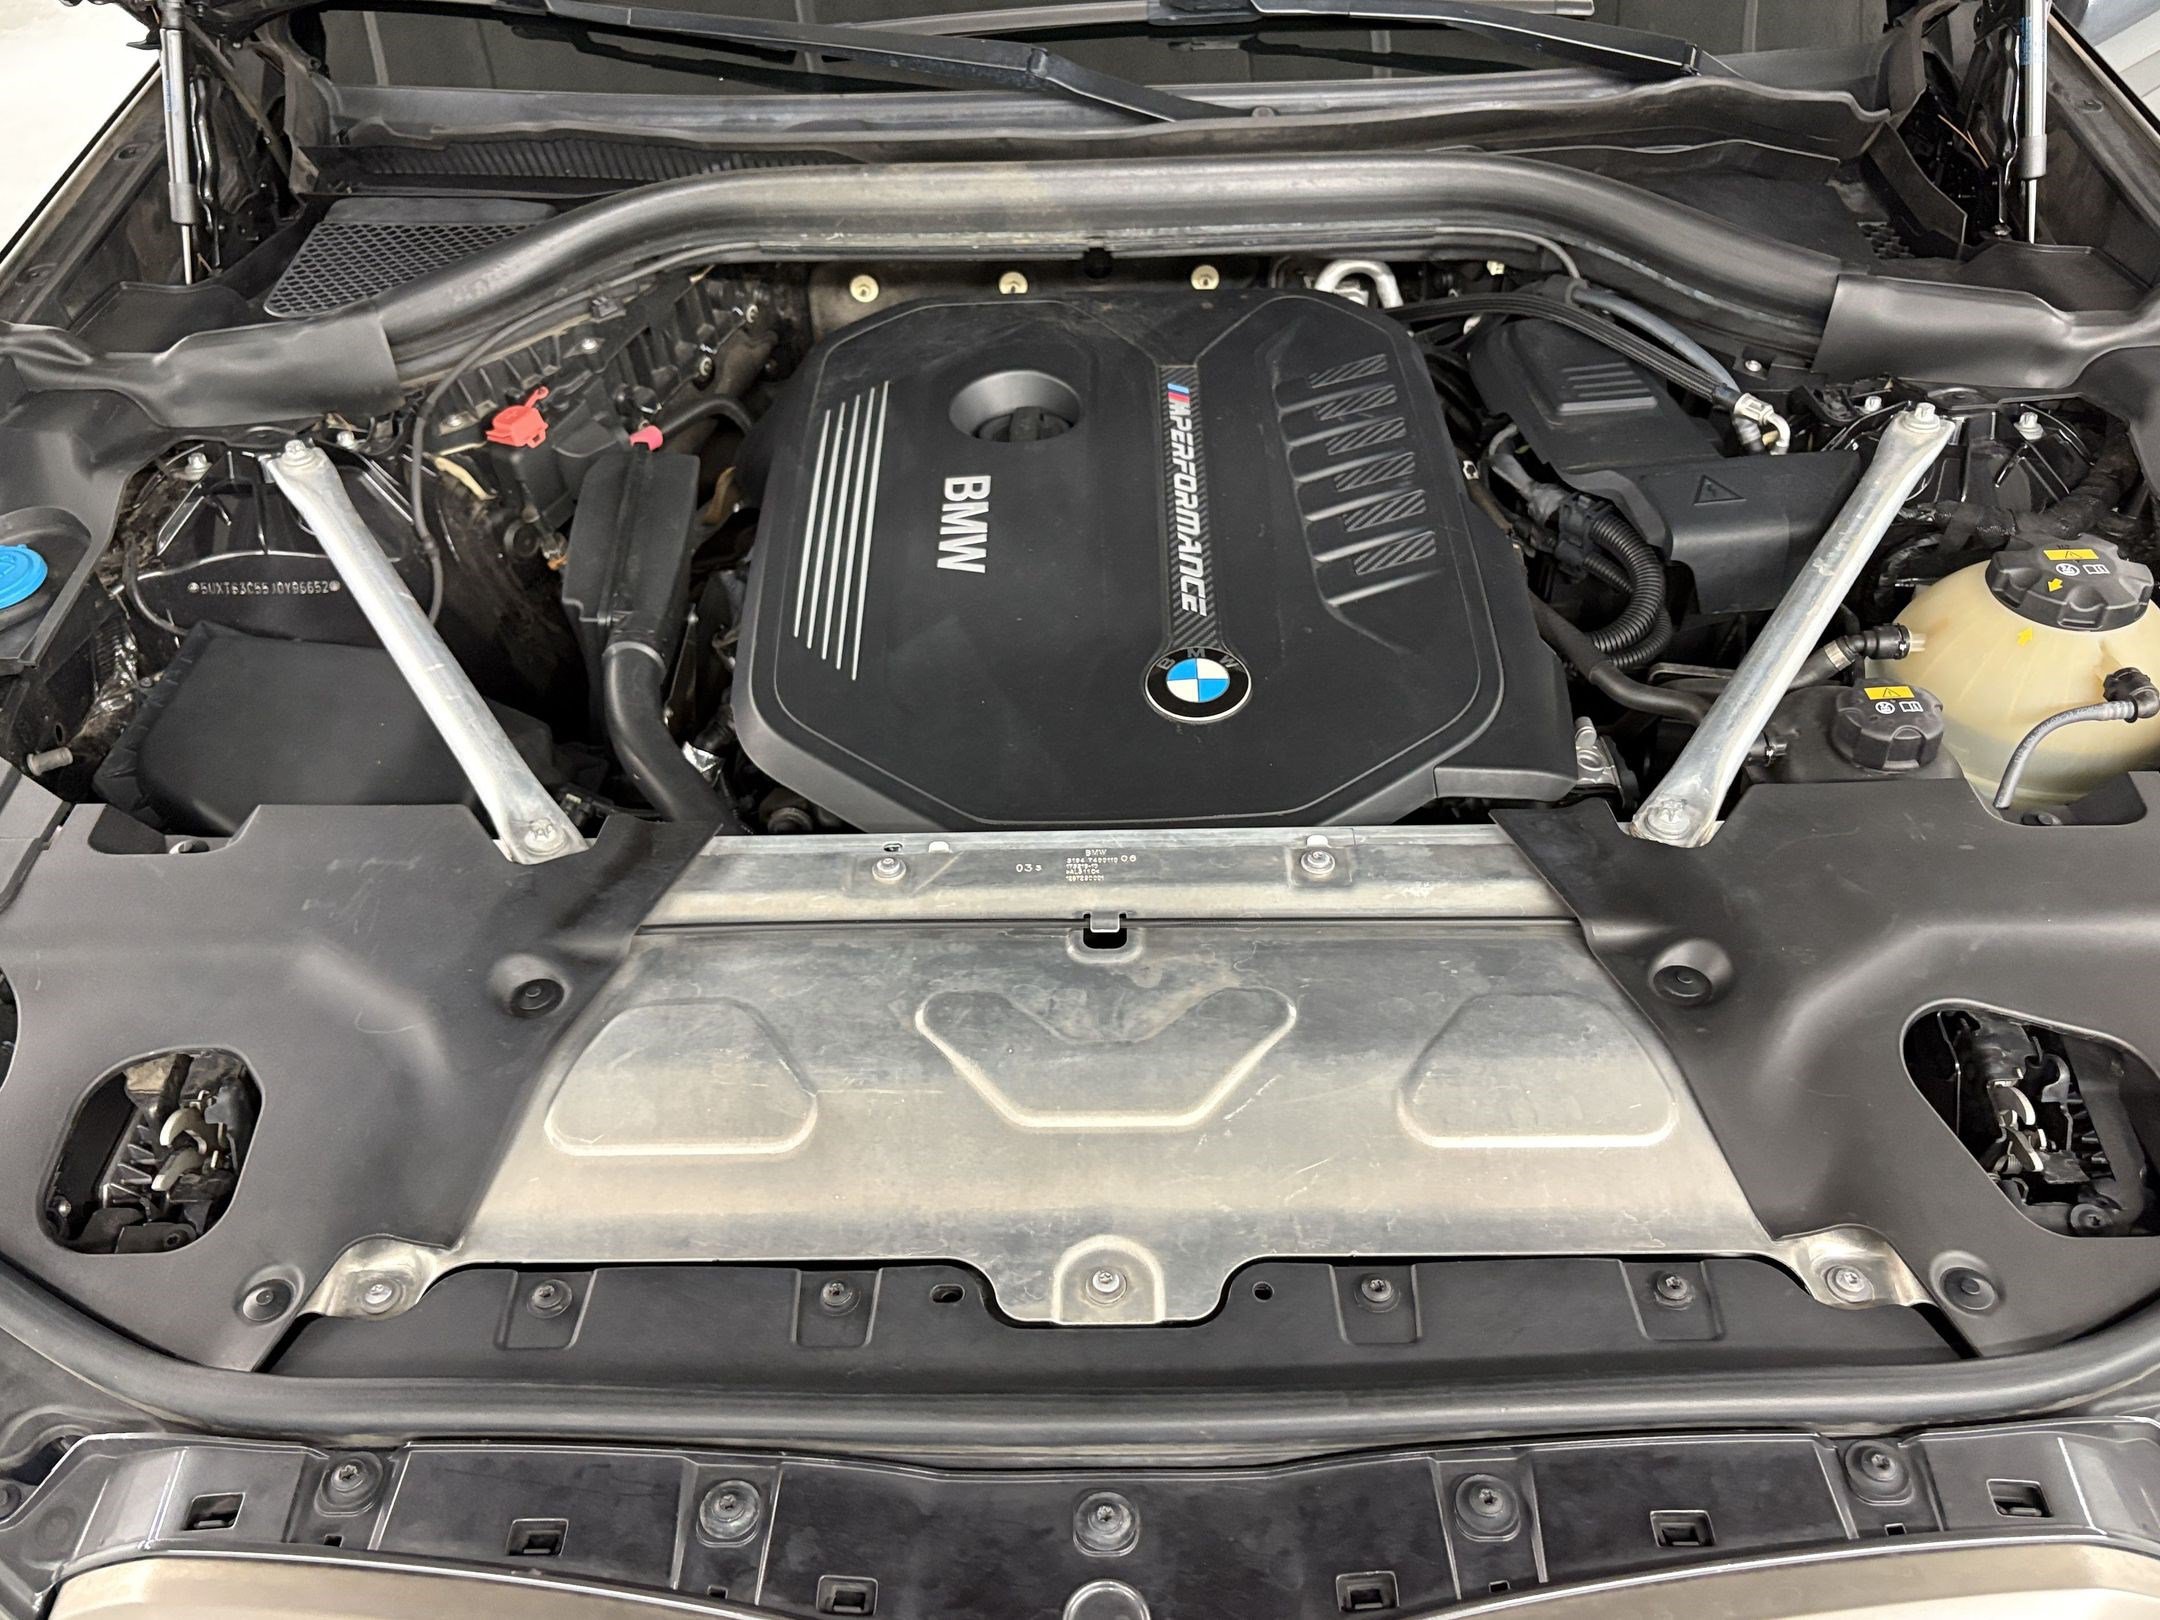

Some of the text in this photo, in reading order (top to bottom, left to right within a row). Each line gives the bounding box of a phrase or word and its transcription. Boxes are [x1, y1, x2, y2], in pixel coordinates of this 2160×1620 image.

[937, 475, 991, 573] BMW
[1156, 648, 1239, 670] BMW
[1085, 849, 1107, 857] BMW
